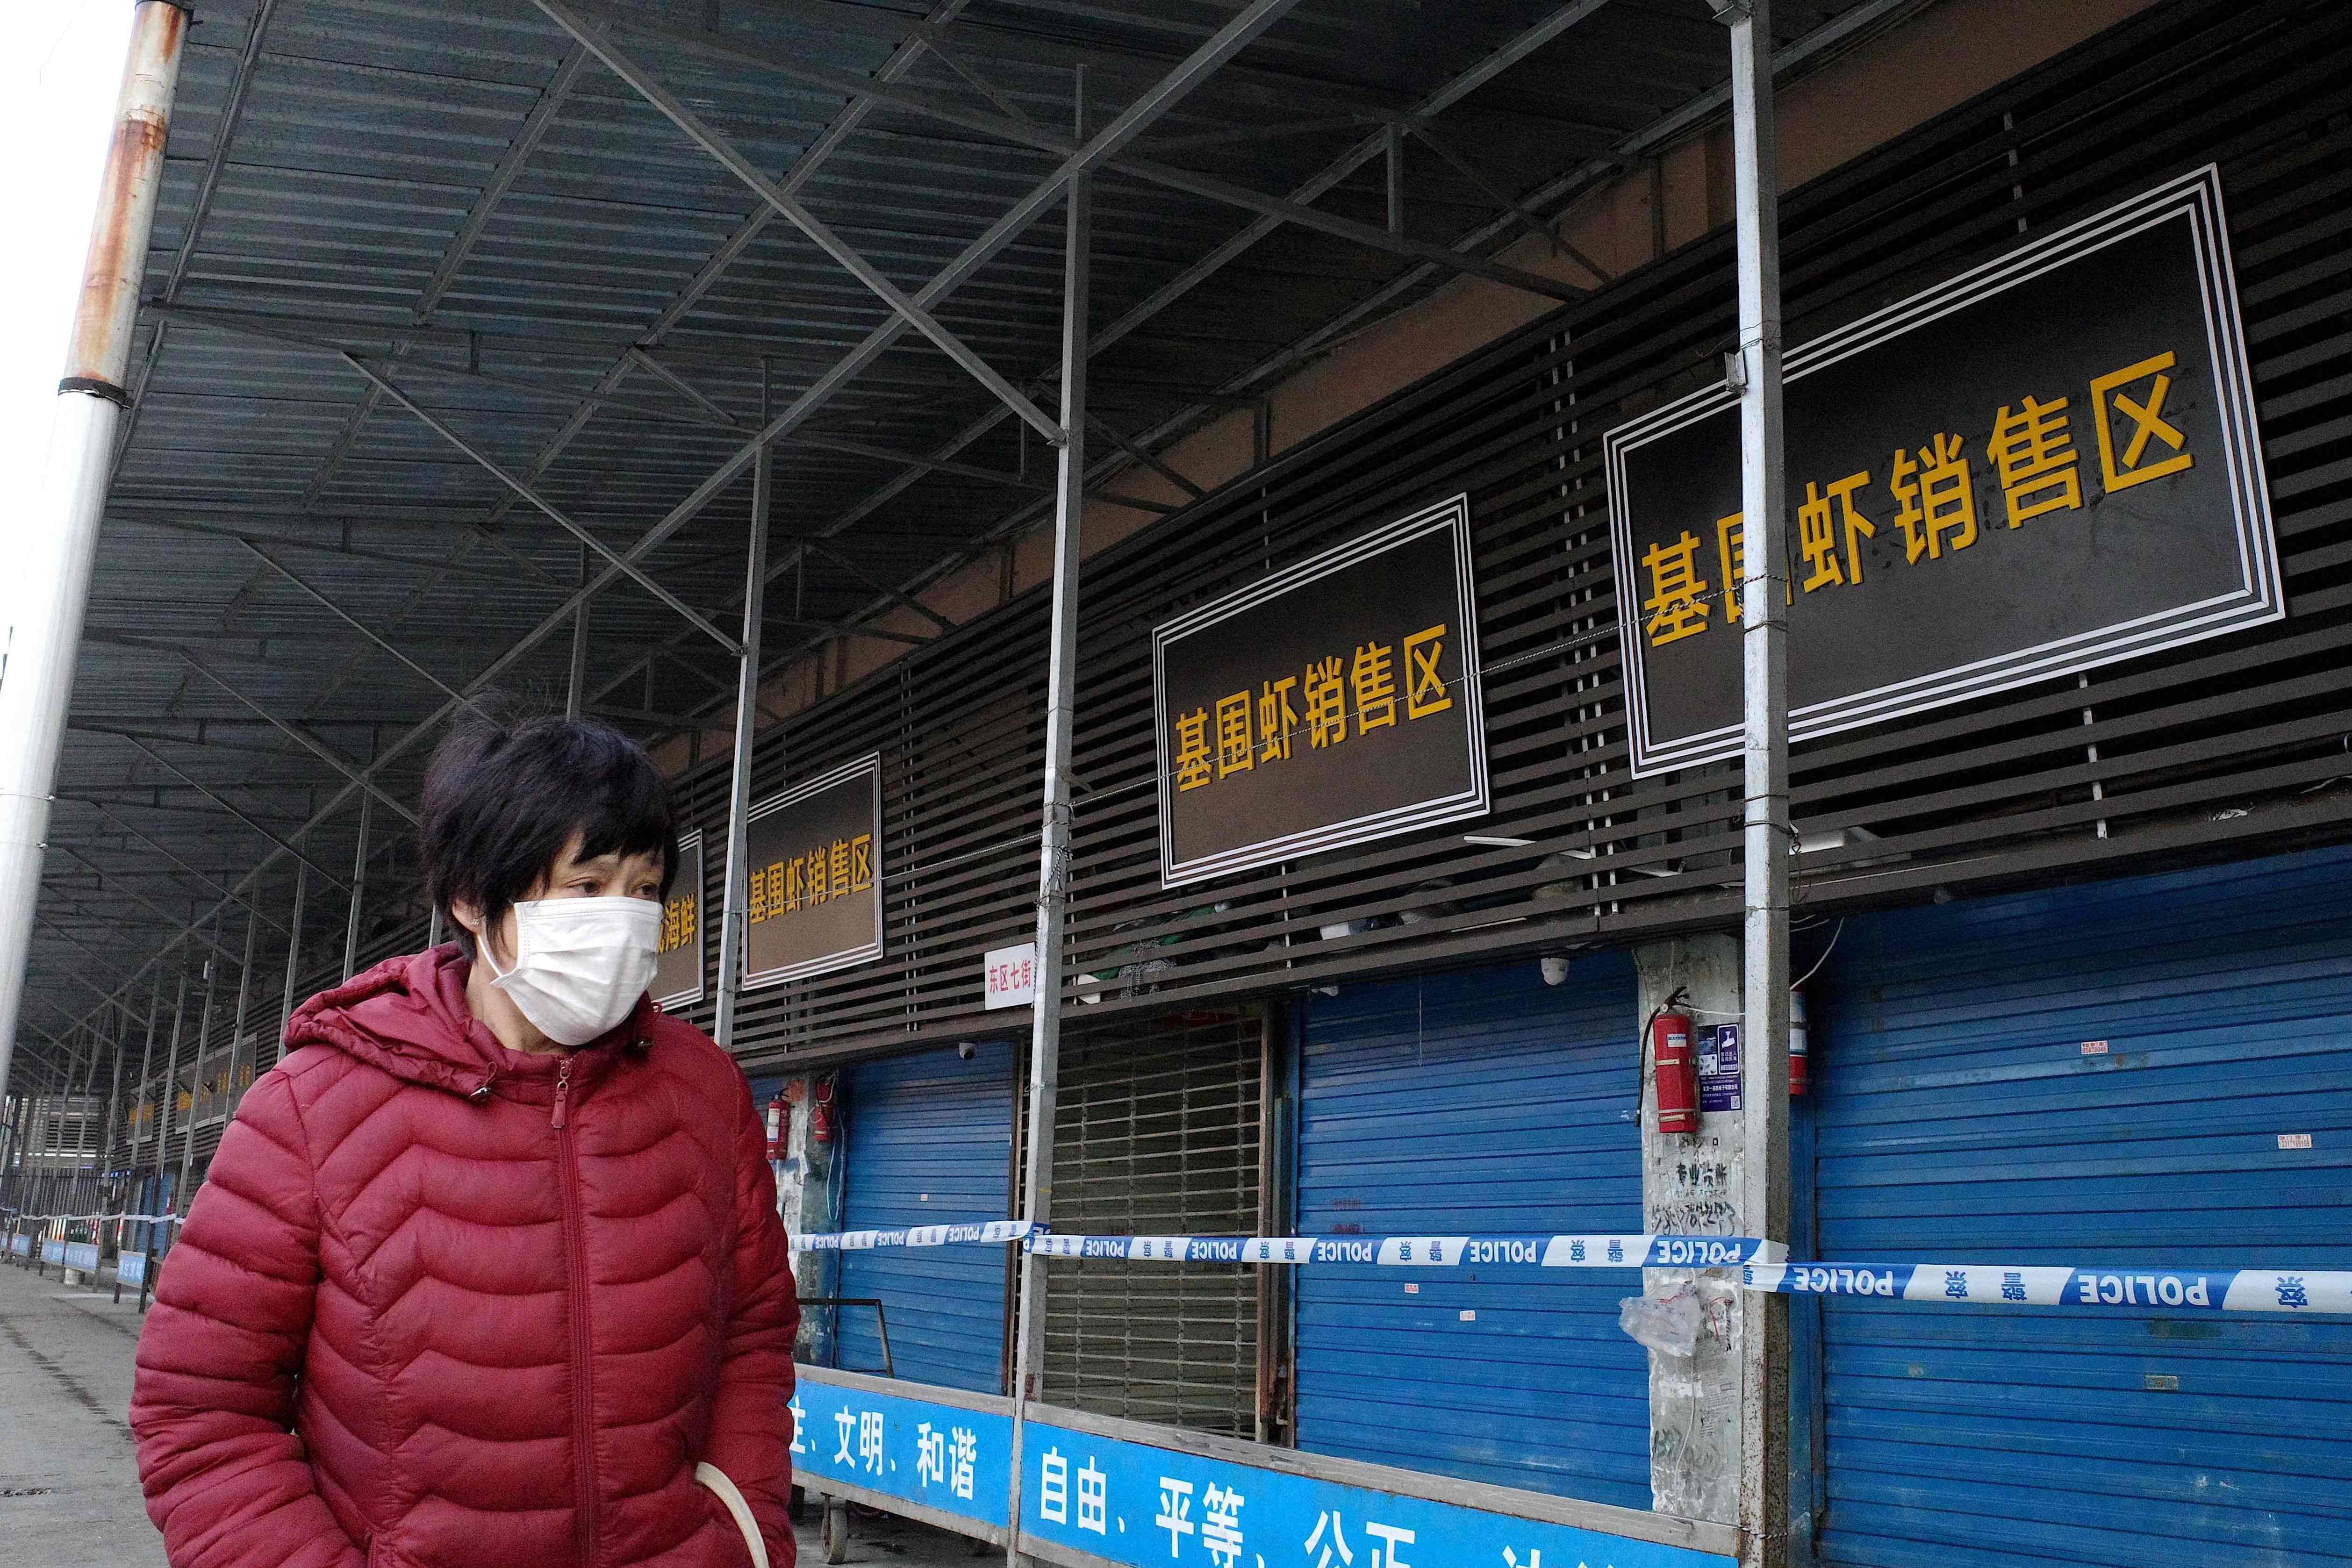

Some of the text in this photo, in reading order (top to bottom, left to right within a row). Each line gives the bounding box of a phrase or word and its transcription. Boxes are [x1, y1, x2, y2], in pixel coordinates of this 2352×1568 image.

[1176, 623, 1453, 792] 基围虾销售区
[749, 833, 874, 924] 基围虾销售区
[658, 893, 696, 954] 海鲜
[990, 959, 1031, 994] 东区七街
[815, 1235, 839, 1249] POLICE
[878, 1232, 904, 1246] POLICE
[948, 1226, 980, 1242] POLICE
[1085, 1240, 1125, 1257] POLICE
[1192, 1241, 1238, 1260] POLICE
[1318, 1241, 1372, 1261] POLICE
[1470, 1241, 1536, 1263] POLICE
[1657, 1240, 1741, 1264] POLICE
[1793, 1267, 1894, 1296] POLICE
[1944, 1271, 2028, 1301] 警察
[2078, 1275, 2210, 1306] POLICE
